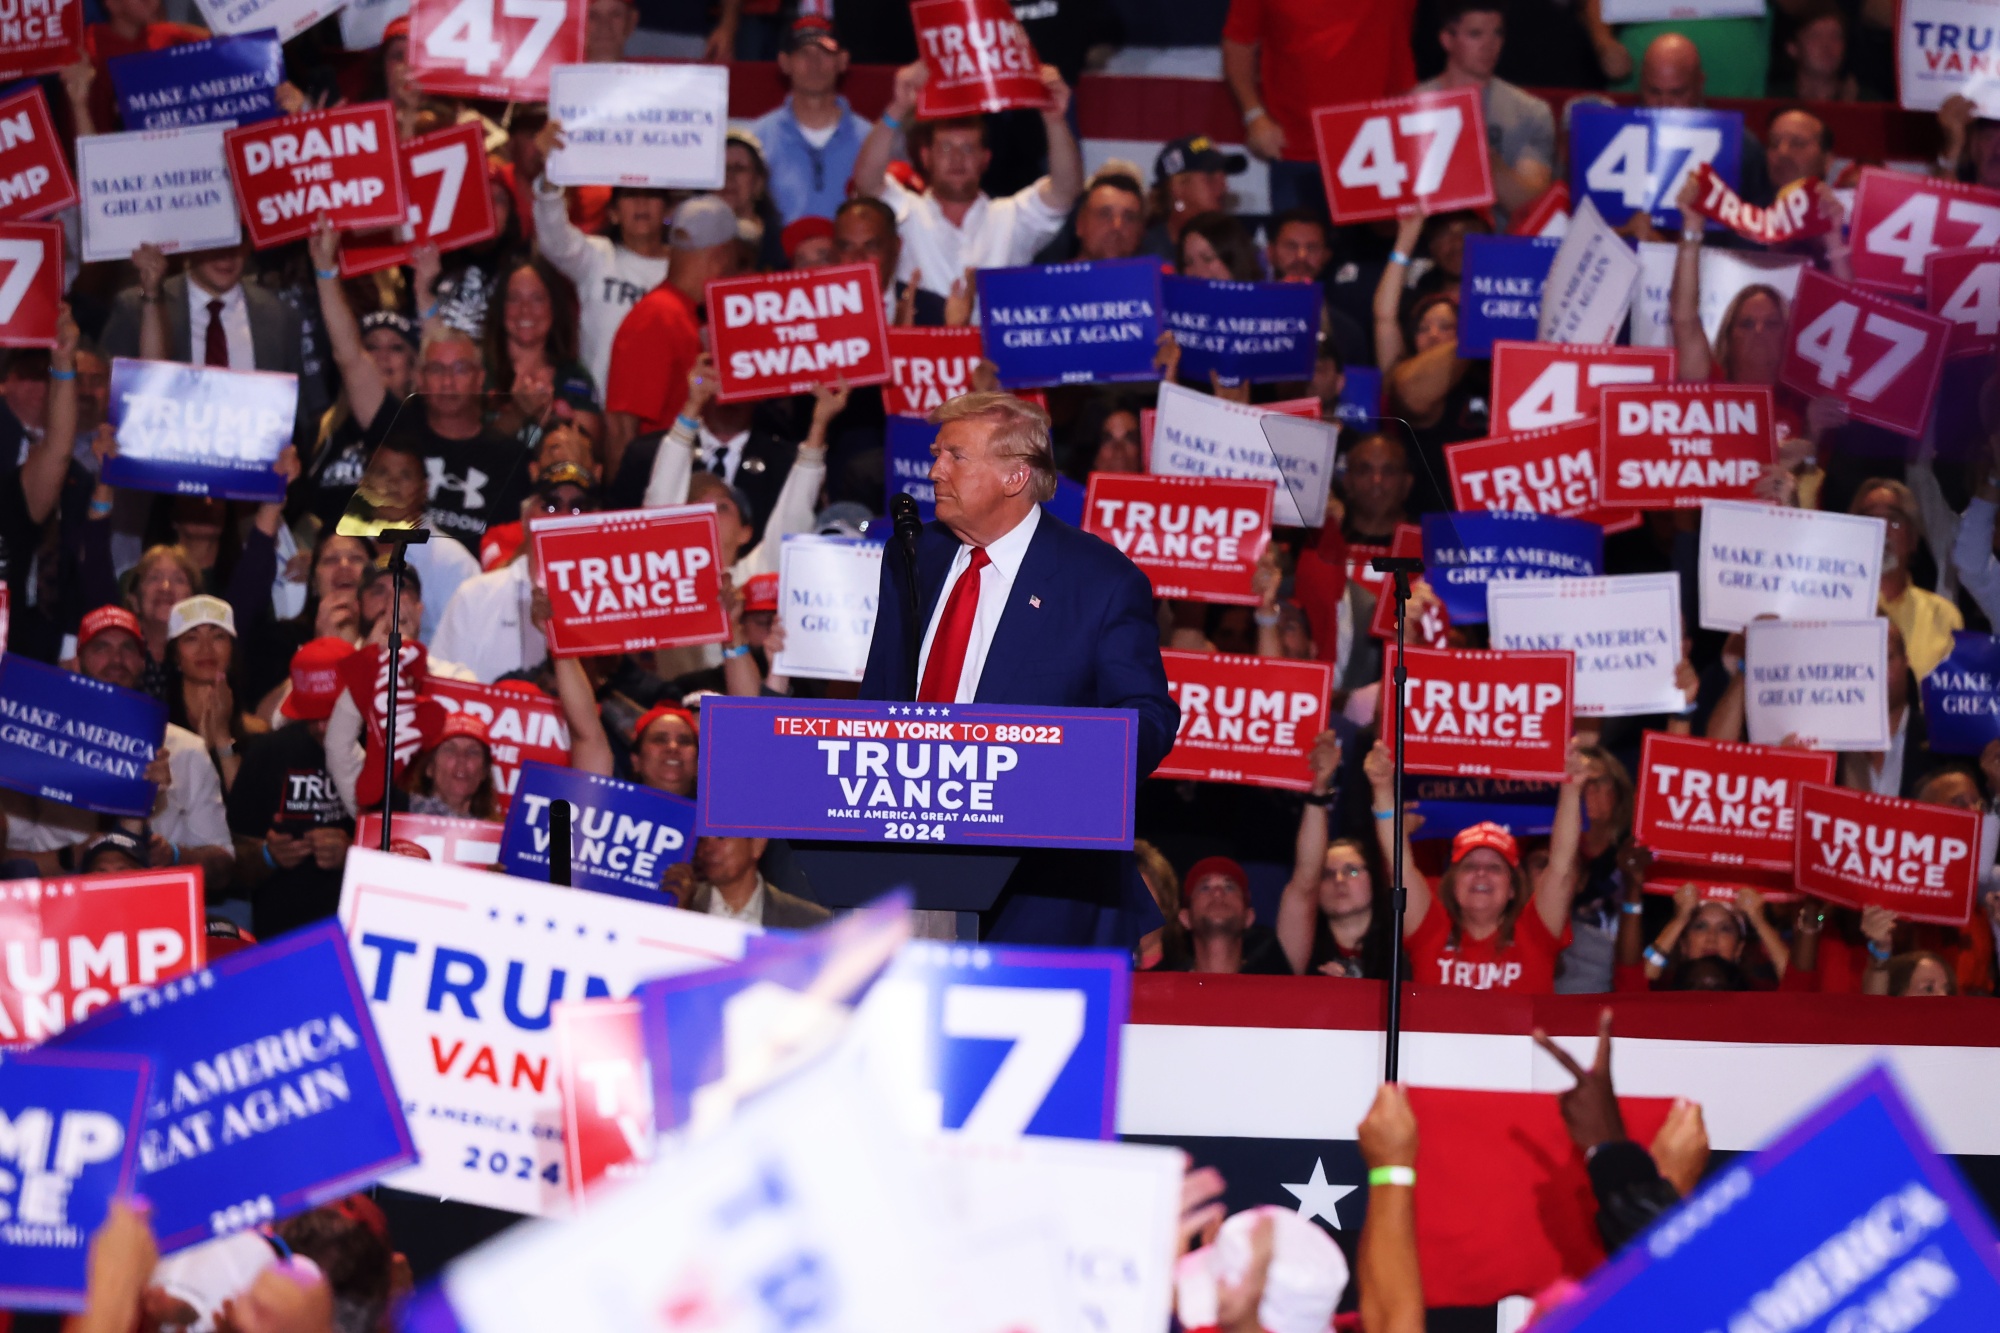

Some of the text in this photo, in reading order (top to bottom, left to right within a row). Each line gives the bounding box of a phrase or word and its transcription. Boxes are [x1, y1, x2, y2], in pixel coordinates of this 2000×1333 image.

[426, 0, 567, 79] 47
[1912, 21, 2000, 52] TRU
[129, 67, 280, 112] MAKE AMERICA
[144, 93, 271, 130] GREAT AGAIN
[0, 110, 36, 151] IN
[642, 129, 702, 147] AGAIN
[243, 119, 378, 177] DRAIN
[1338, 106, 1463, 199] 47
[290, 161, 333, 187] THE
[1586, 123, 1721, 209] 47
[91, 177, 147, 196] MAKE
[257, 176, 384, 226] SWAMP
[401, 142, 489, 243] 7
[103, 191, 221, 218] GREAT AGAIN
[1703, 173, 1809, 239] TRUMP
[1472, 276, 1534, 296] MAKE
[724, 280, 863, 329] DRAIN
[991, 299, 1154, 326] MAKE AMERICA
[1481, 300, 1539, 319] GREA
[773, 322, 818, 345] THE
[1003, 323, 1144, 348] GREAT AGAIN
[1163, 311, 1308, 335] AKE AMERICA
[730, 337, 871, 380] SWAMP
[1230, 337, 1296, 354] AGAIN
[1796, 300, 1928, 403] 47
[1617, 400, 1759, 435] DRAIN
[1165, 427, 1319, 476] MAKE AMERICA
[1669, 437, 1713, 457] THE
[1617, 459, 1761, 489] SWAMP
[1096, 499, 1260, 540] TRUMP
[1111, 530, 1240, 562] VANCE
[1434, 546, 1500, 566] MAKE
[1503, 547, 1594, 577] AMERICA
[1712, 545, 1867, 579] MAKE AMERICA
[547, 546, 711, 591] TRUMP
[1718, 571, 1854, 599] GREAT AGAIN
[570, 578, 697, 615] VANCE
[1573, 628, 1668, 649] AMERICA
[1592, 654, 1657, 673] AGAIN
[1753, 664, 1875, 683] MAKE AMERICA
[1758, 688, 1866, 707] GREAT AGAIN
[1931, 671, 1991, 691] MAKE
[0, 698, 155, 761] MAKE AMERICA
[776, 717, 1061, 744] TEXT NEW YORK TO 88022
[1410, 708, 1543, 739] VANCE
[1, 725, 139, 781] GREAT AGAIN
[818, 740, 1018, 781] TRUMP
[839, 778, 995, 811] VANCE
[827, 809, 1005, 824] MAKE AMERICA GREAT AGAIN!
[1668, 796, 1795, 832] VANCE
[884, 822, 946, 841] 2024
[1806, 811, 1968, 866] TRUMP
[1820, 843, 1946, 888] VANCE
[171, 1012, 358, 1103] AMERICA
[222, 1062, 352, 1146] AGAIN
[463, 1146, 561, 1185] 2024
